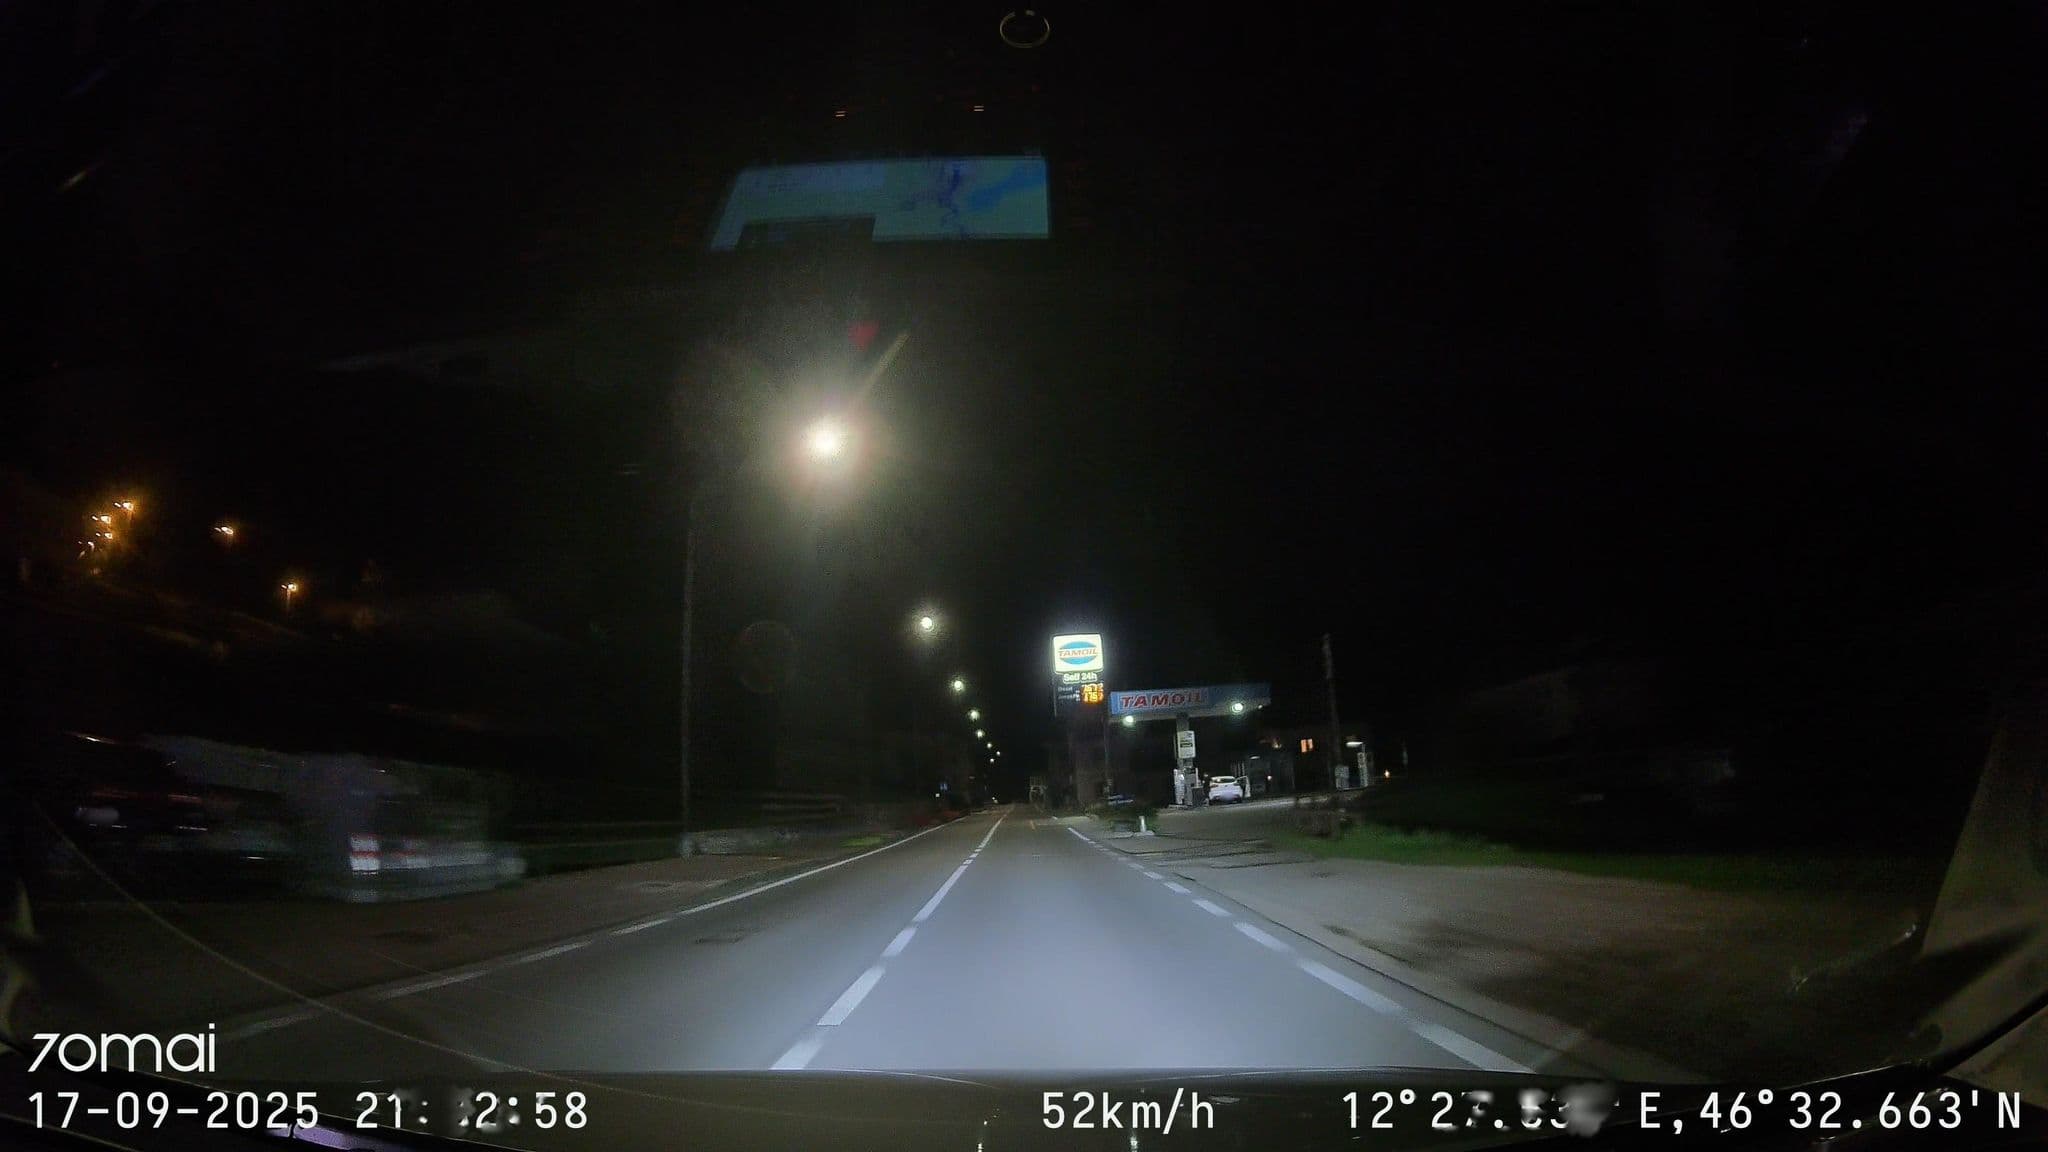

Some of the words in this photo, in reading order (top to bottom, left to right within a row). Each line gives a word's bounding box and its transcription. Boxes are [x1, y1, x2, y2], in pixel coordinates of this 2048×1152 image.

[1058, 648, 1096, 657] TAMOIL
[1064, 673, 1080, 681] Self
[1081, 672, 1097, 681] 24h
[1121, 692, 1202, 708] TAMOIL
